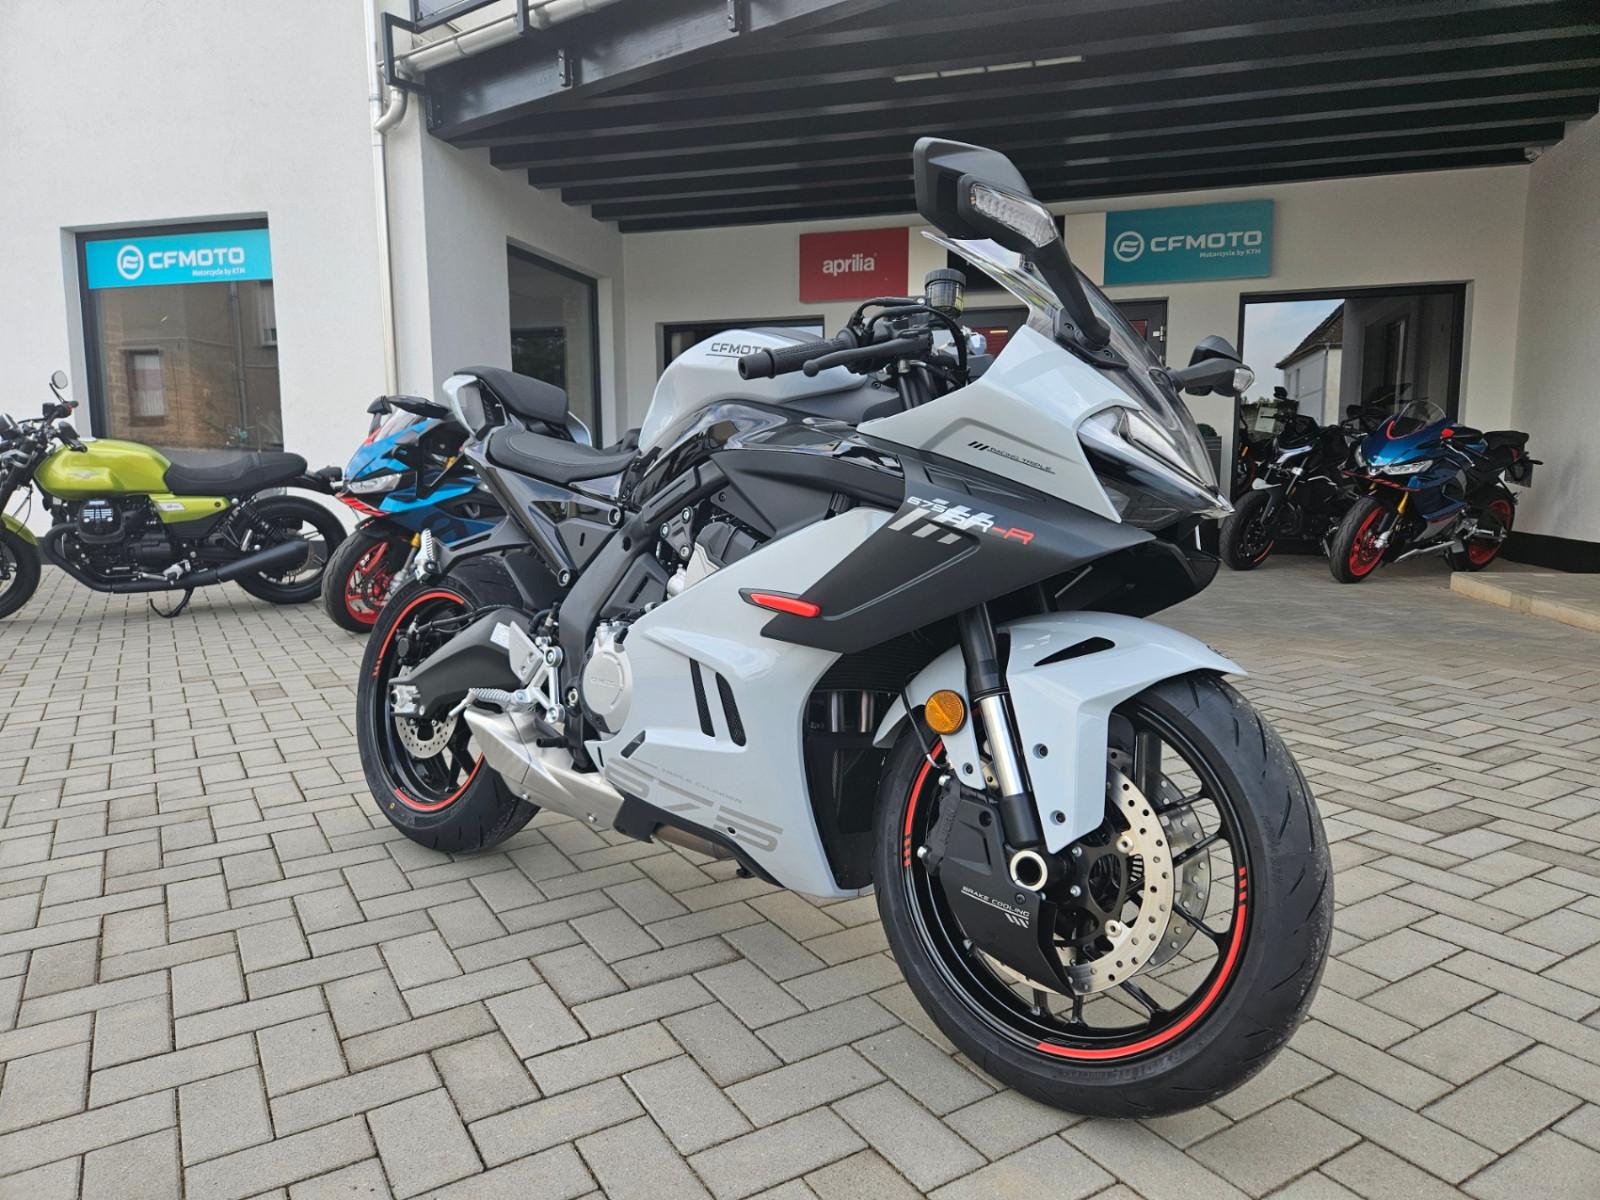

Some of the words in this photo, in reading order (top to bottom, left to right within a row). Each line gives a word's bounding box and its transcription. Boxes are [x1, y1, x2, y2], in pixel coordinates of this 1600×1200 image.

[1150, 230, 1262, 252] CFMOTO
[148, 246, 245, 269] CFMOTO
[822, 253, 875, 276] aprilia
[1199, 250, 1236, 258] Motorcycle
[711, 342, 764, 355] CFMOT
[962, 885, 990, 902] BRAKE
[991, 898, 1031, 918] COOLING
